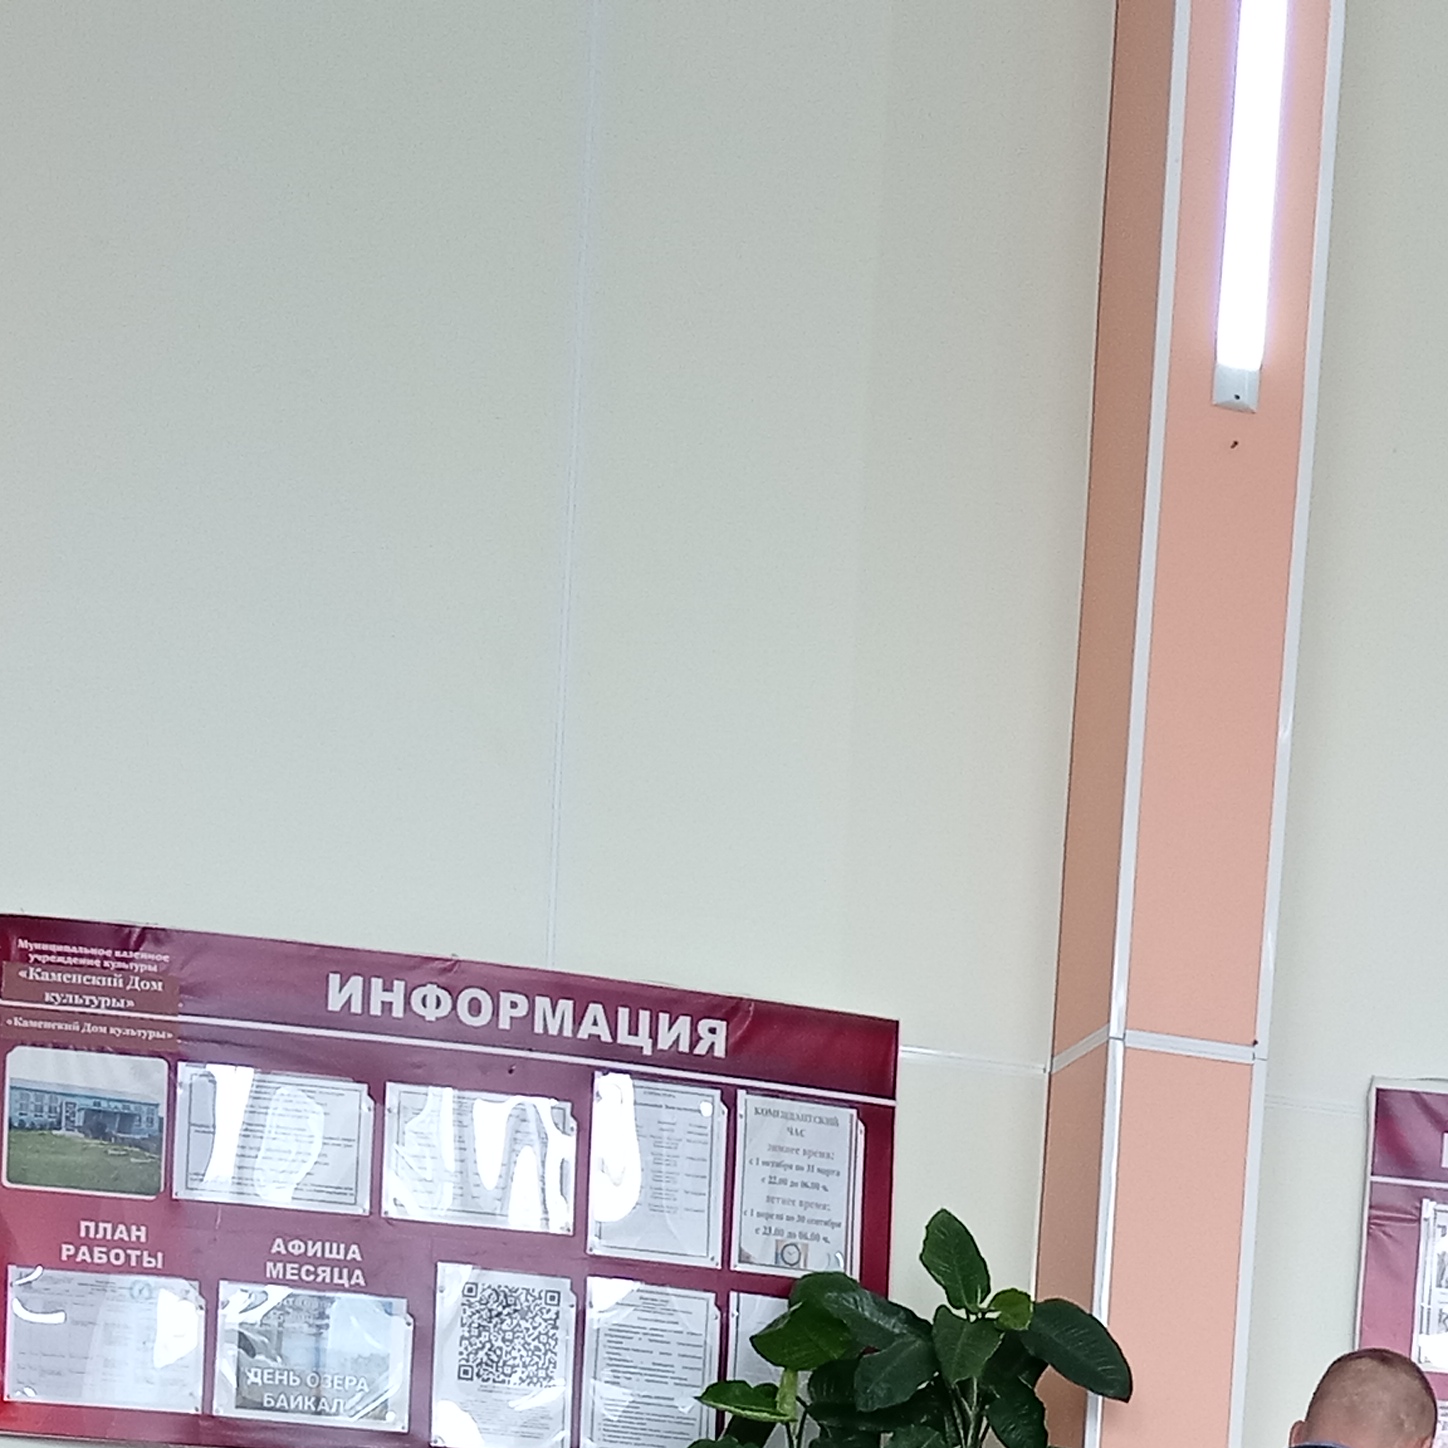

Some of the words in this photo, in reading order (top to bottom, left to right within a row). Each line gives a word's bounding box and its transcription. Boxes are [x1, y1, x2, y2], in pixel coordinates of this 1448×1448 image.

[17, 938, 113, 958] Муниципальное
[28, 952, 102, 967] учреждение
[102, 959, 158, 973] культуры
[18, 967, 124, 988] «Каменский
[126, 975, 164, 992] Дом
[44, 991, 135, 1009] культуры»
[326, 971, 729, 1059] ИНФОРМАЦИЯ
[81, 1022, 108, 1034] Дом
[78, 1220, 147, 1244] ПЛАН
[60, 1243, 164, 1269] РАБОТЫ
[269, 1237, 363, 1262] АФИША
[265, 1261, 367, 1287] МЕСЯЦА
[247, 1367, 301, 1387] ДЕНЬ
[306, 1372, 370, 1393] ОЗЕРА
